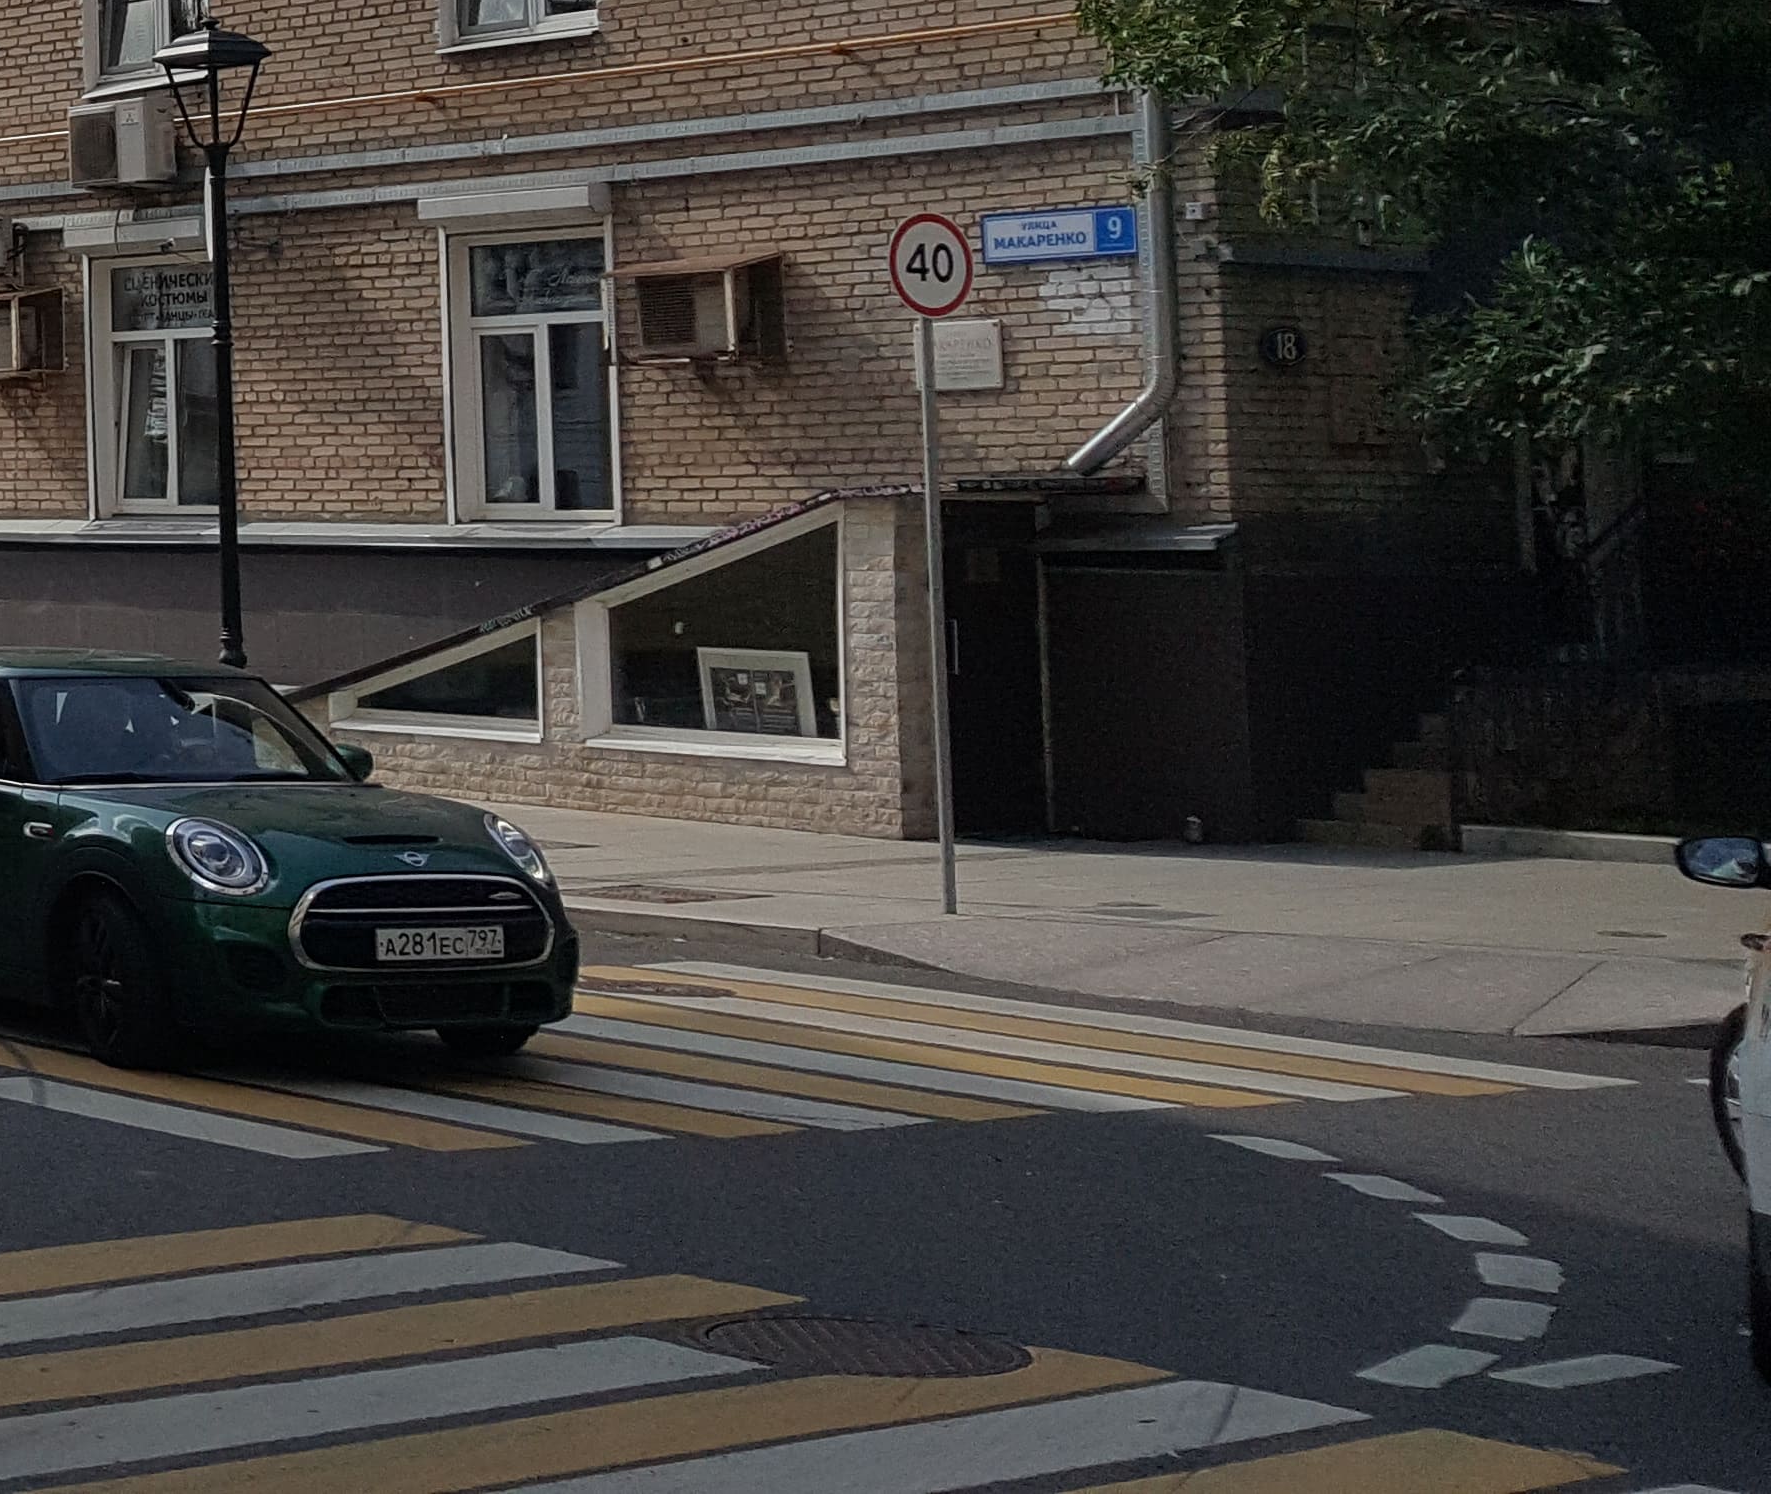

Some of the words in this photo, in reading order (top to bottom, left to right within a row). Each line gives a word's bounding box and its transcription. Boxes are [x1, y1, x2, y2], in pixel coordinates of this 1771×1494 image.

[1020, 220, 1058, 231] УЛИЦА
[1107, 216, 1123, 239] 9
[993, 231, 1087, 250] МАКАРЕНКО
[905, 242, 954, 283] 40
[123, 272, 214, 292] СЦЕНИЧЕСКИ
[141, 290, 208, 307] КОСТЮМЫ
[1276, 332, 1297, 360] 18
[467, 929, 498, 947] 797
